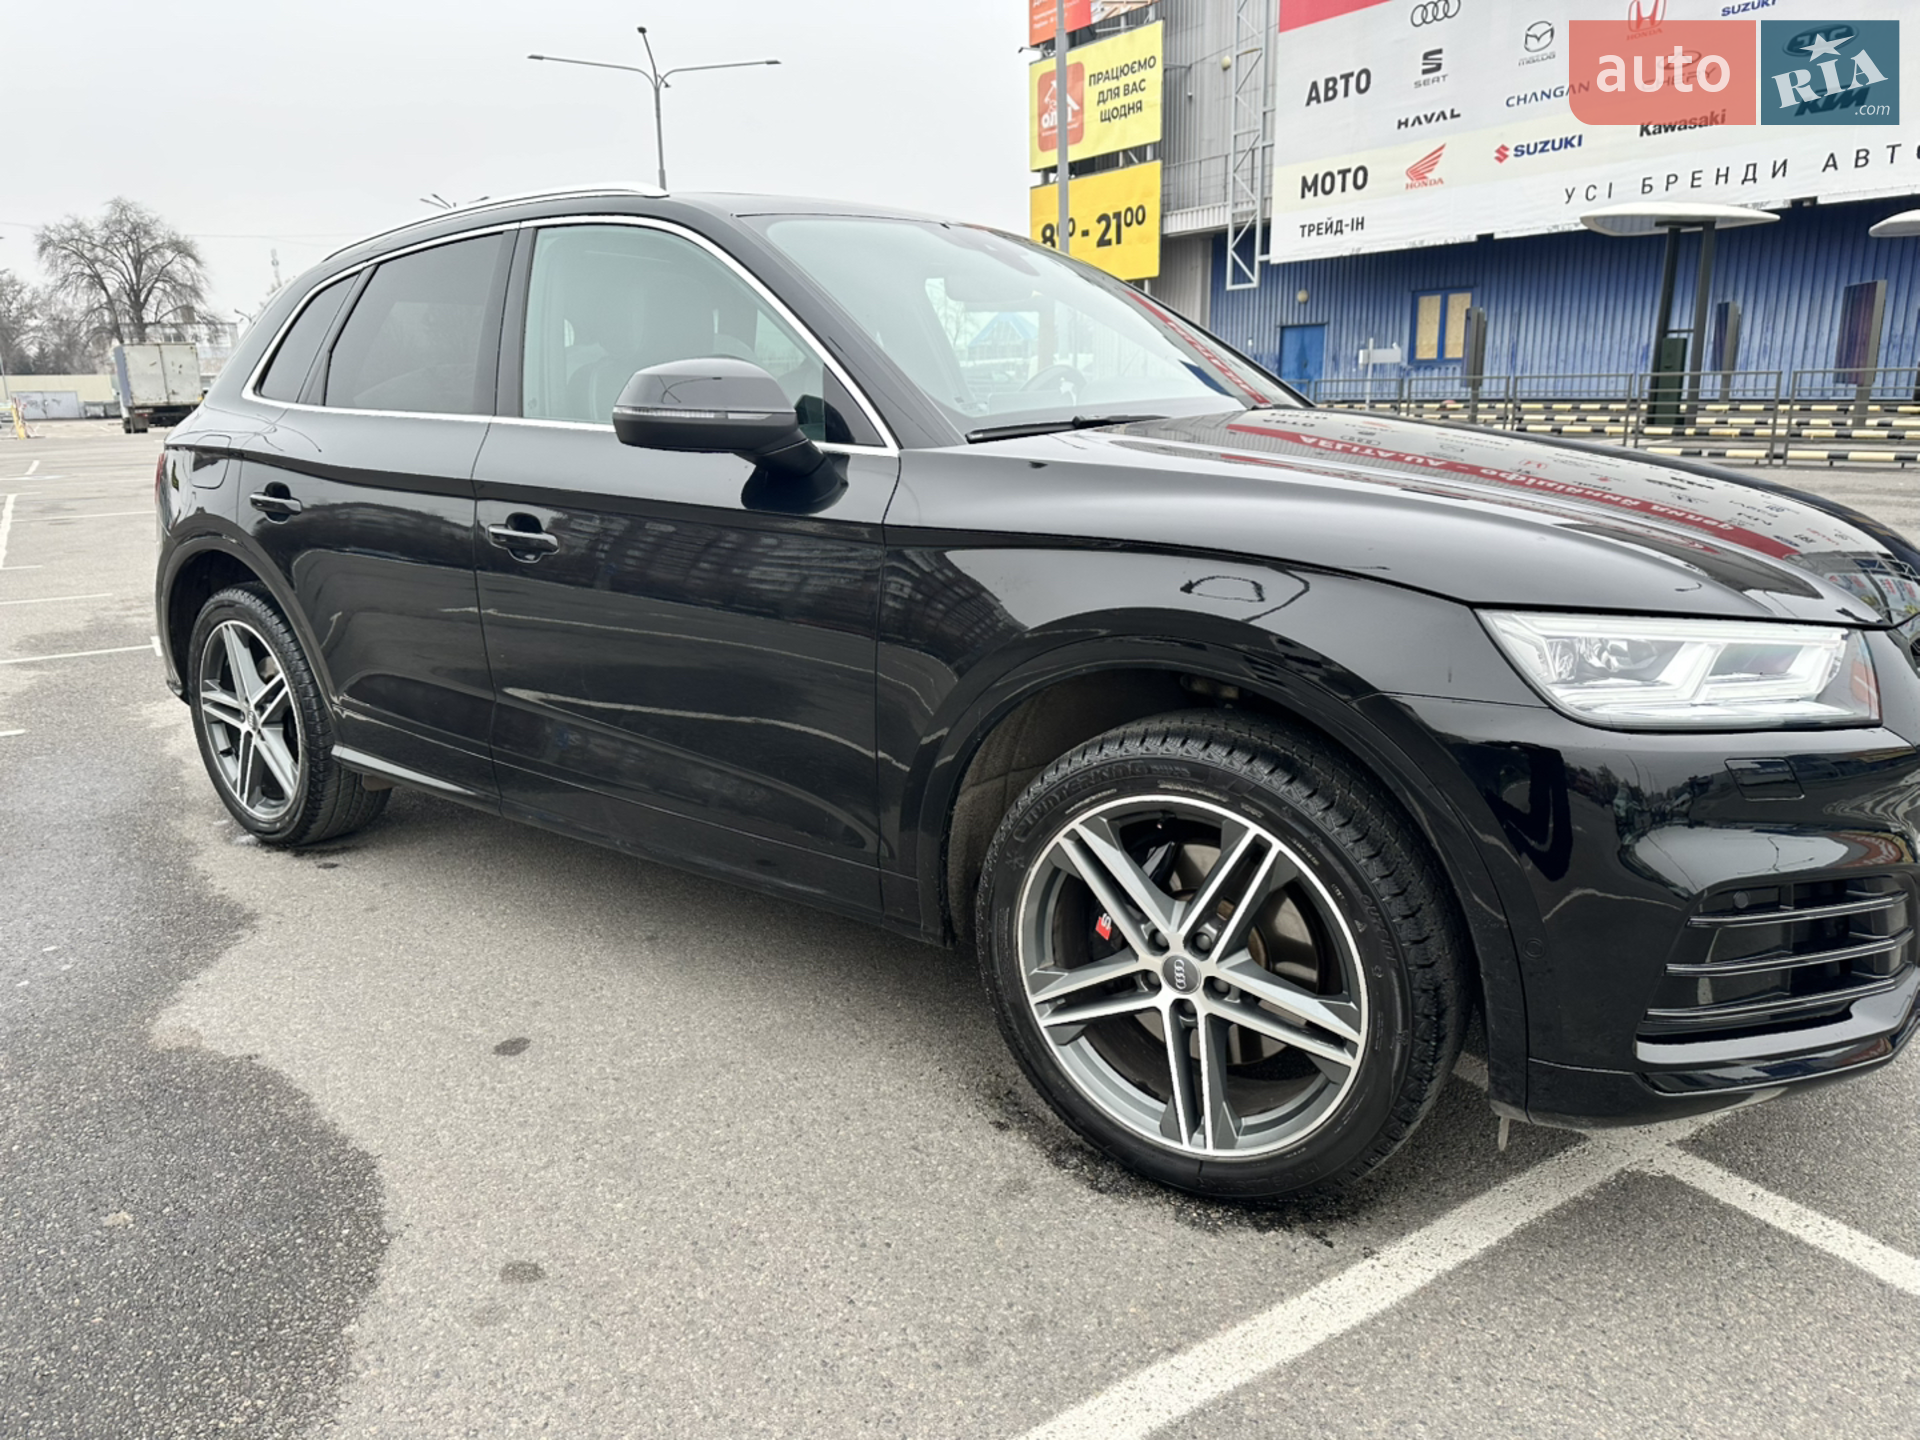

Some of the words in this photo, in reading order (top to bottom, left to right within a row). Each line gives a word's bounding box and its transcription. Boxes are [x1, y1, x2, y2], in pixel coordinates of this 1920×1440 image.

[1088, 55, 1157, 87] ПРАЦЮЄМО
[1414, 73, 1449, 89] SEAT
[1096, 86, 1120, 106] ДЛЯ
[1123, 78, 1146, 97] ВАС
[1305, 68, 1372, 107] АВТО
[1505, 80, 1590, 107] CHANGAN
[1099, 100, 1143, 122] ЩОДНЯ
[1397, 108, 1461, 130] HAVAL
[1639, 109, 1727, 138] Kawasaki
[1513, 134, 1583, 158] SUZUKI
[1300, 165, 1369, 200] МОТО
[1405, 177, 1445, 190] HONDA
[1564, 182, 1613, 204] УСІ
[1641, 158, 1789, 195] БРЕНДИ
[1300, 216, 1365, 238] ТРЕЙД-ІН
